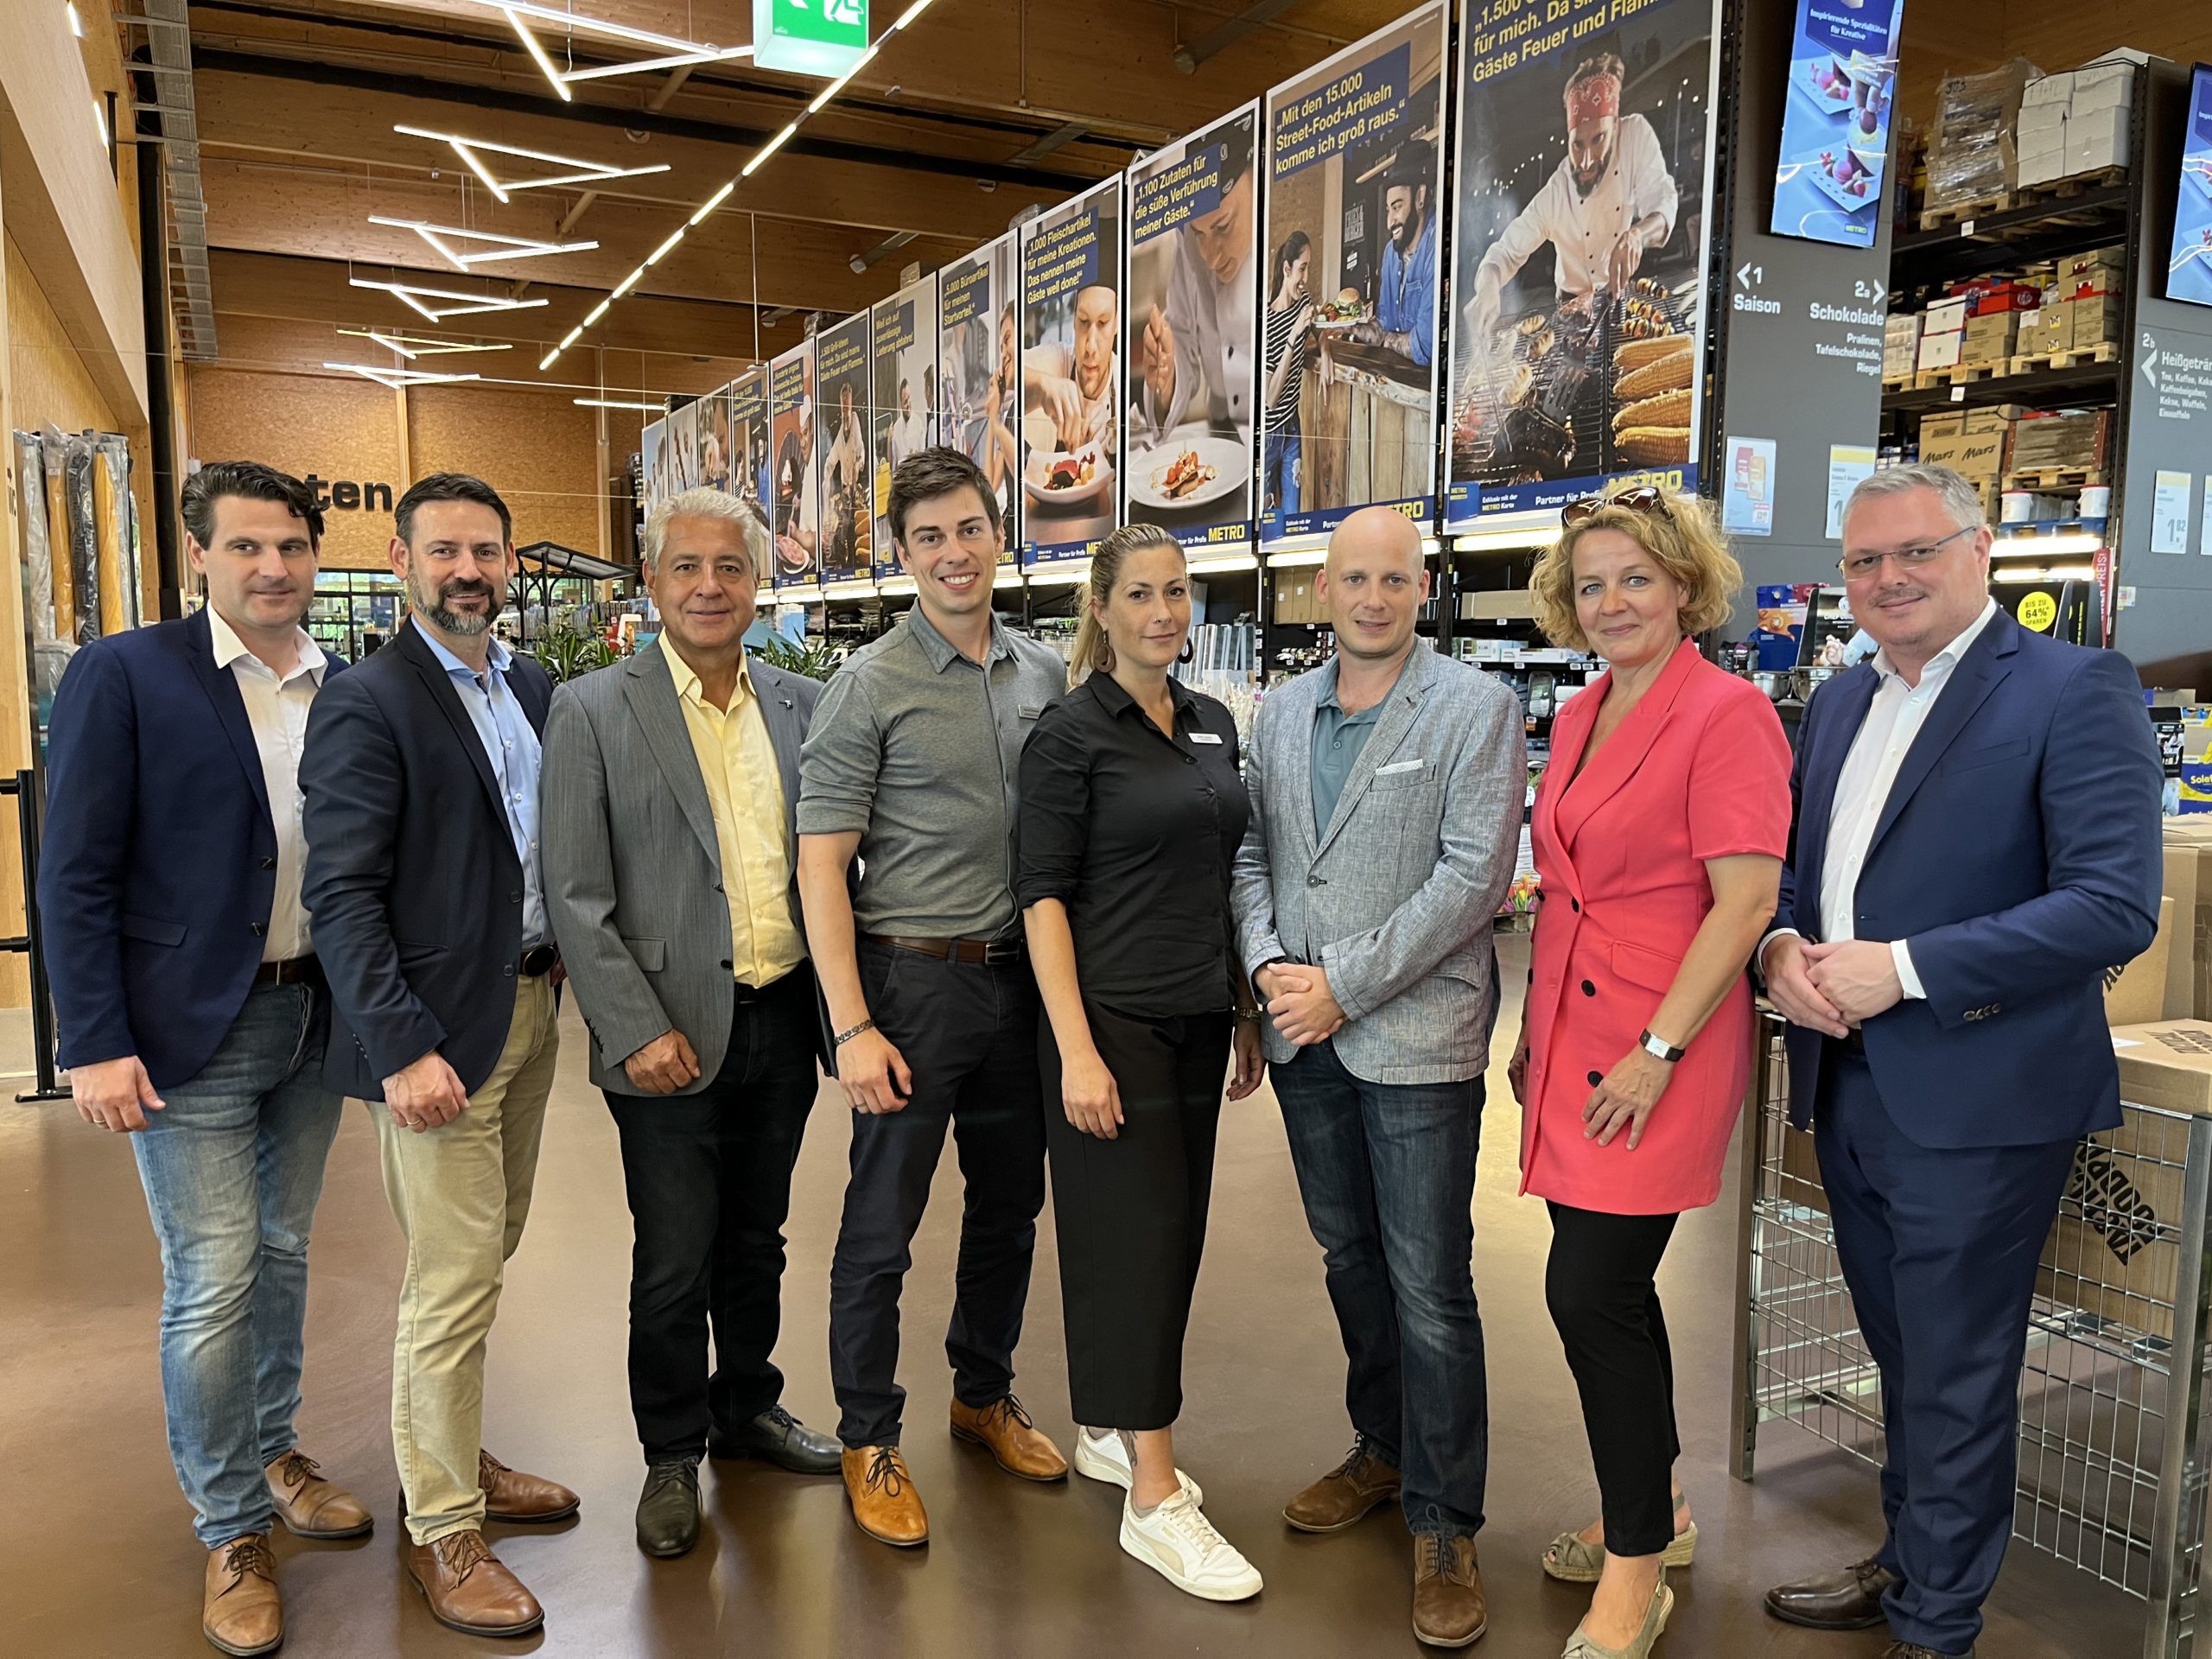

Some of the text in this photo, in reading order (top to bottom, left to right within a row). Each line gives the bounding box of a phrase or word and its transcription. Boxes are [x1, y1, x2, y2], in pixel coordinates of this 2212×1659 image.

[1472, 52, 1517, 83] Gäste
[1522, 27, 1569, 61] Feuer
[1573, 5, 1605, 38] und
[1473, 0, 1569, 57] für mich. Da
[1276, 72, 1362, 132] „Mit den 15.000
[1276, 84, 1392, 152] Street-Food-Artikeln
[1276, 99, 1406, 174] komme ich groß raus.“
[1135, 156, 1206, 204] „1.100 Zutaten für
[1135, 171, 1217, 220] die süße Verführung
[1048, 213, 1091, 245] Fleischartikel
[1135, 200, 1194, 239] meiner Gäste.“
[1027, 232, 1096, 271] für meine Kreationen.
[1027, 254, 1086, 288] Das nennen meine
[1752, 266, 1871, 298] 1 2a
[1027, 289, 1046, 304] Gäste
[1046, 280, 1060, 296] well
[1733, 293, 1885, 326] Saison Schokolade
[1815, 343, 1881, 361] Tafelschokolade,
[1847, 332, 1882, 347] Pralinen,
[2142, 332, 2155, 348] 2b
[1856, 362, 1881, 376] Riegel
[1923, 445, 1996, 464] Mars Mars
[1535, 495, 1565, 505] Partner
[1566, 493, 1579, 502] für
[1208, 524, 1245, 542] METRO
